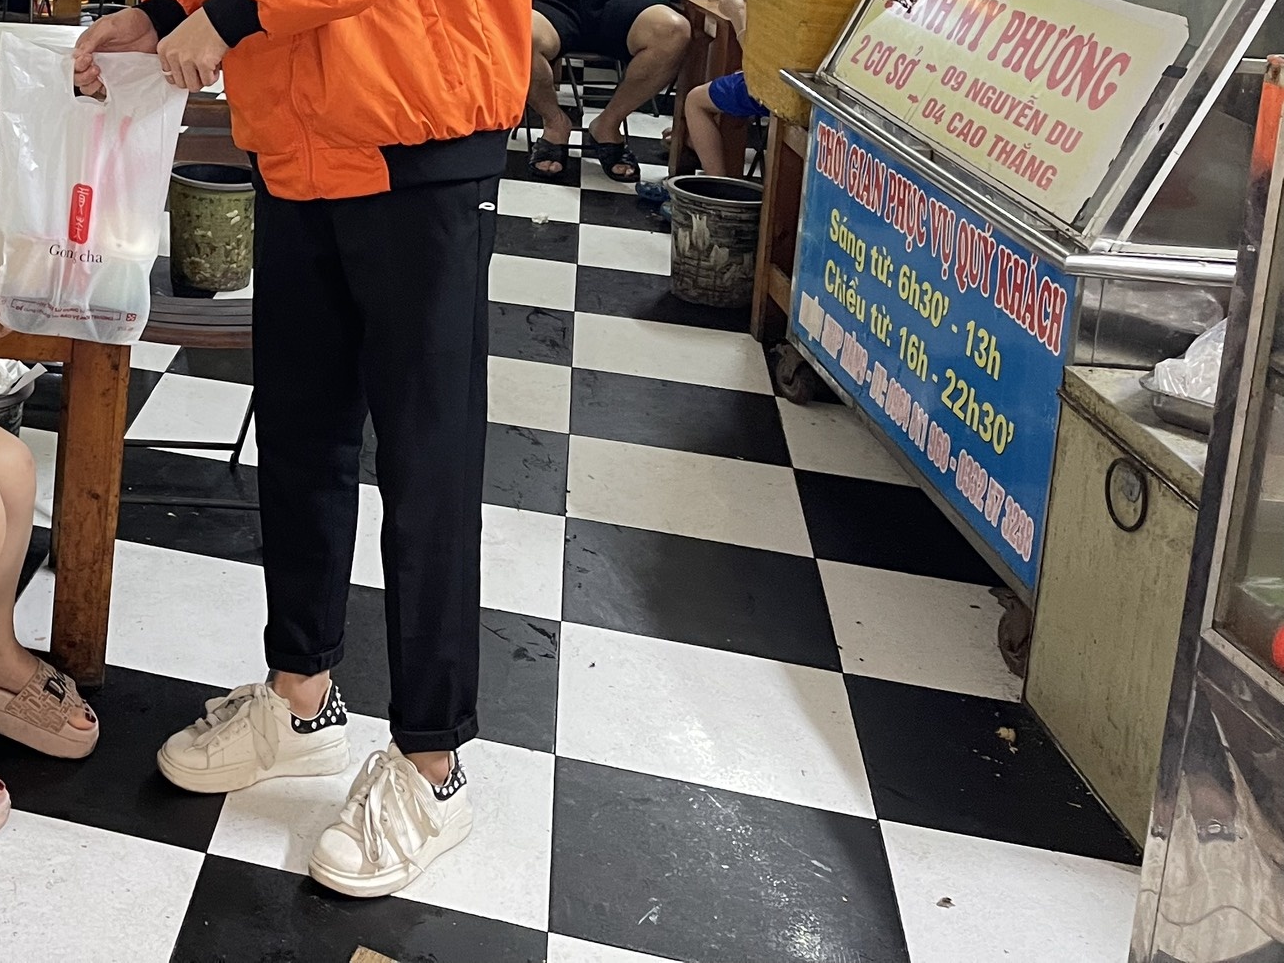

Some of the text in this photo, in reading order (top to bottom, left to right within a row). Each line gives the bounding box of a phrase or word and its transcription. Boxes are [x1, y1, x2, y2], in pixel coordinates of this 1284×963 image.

[850, 34, 1084, 153] 2 CƠ SỞ 09 NGUYỄN DU
[987, 9, 1132, 111] PHƯƠNG
[922, 97, 1058, 191] 04 CAO THẮNG
[49, 243, 104, 264] Gon cha
[816, 121, 1067, 356] THỜI GIAN PHỤC VỤ QUÝ KHÁCH
[829, 208, 866, 273] Sáng
[870, 246, 894, 288] từ:
[966, 320, 1002, 381] 13h
[824, 259, 866, 323] Chiều
[870, 304, 893, 348] từ:
[899, 326, 929, 383] 16h
